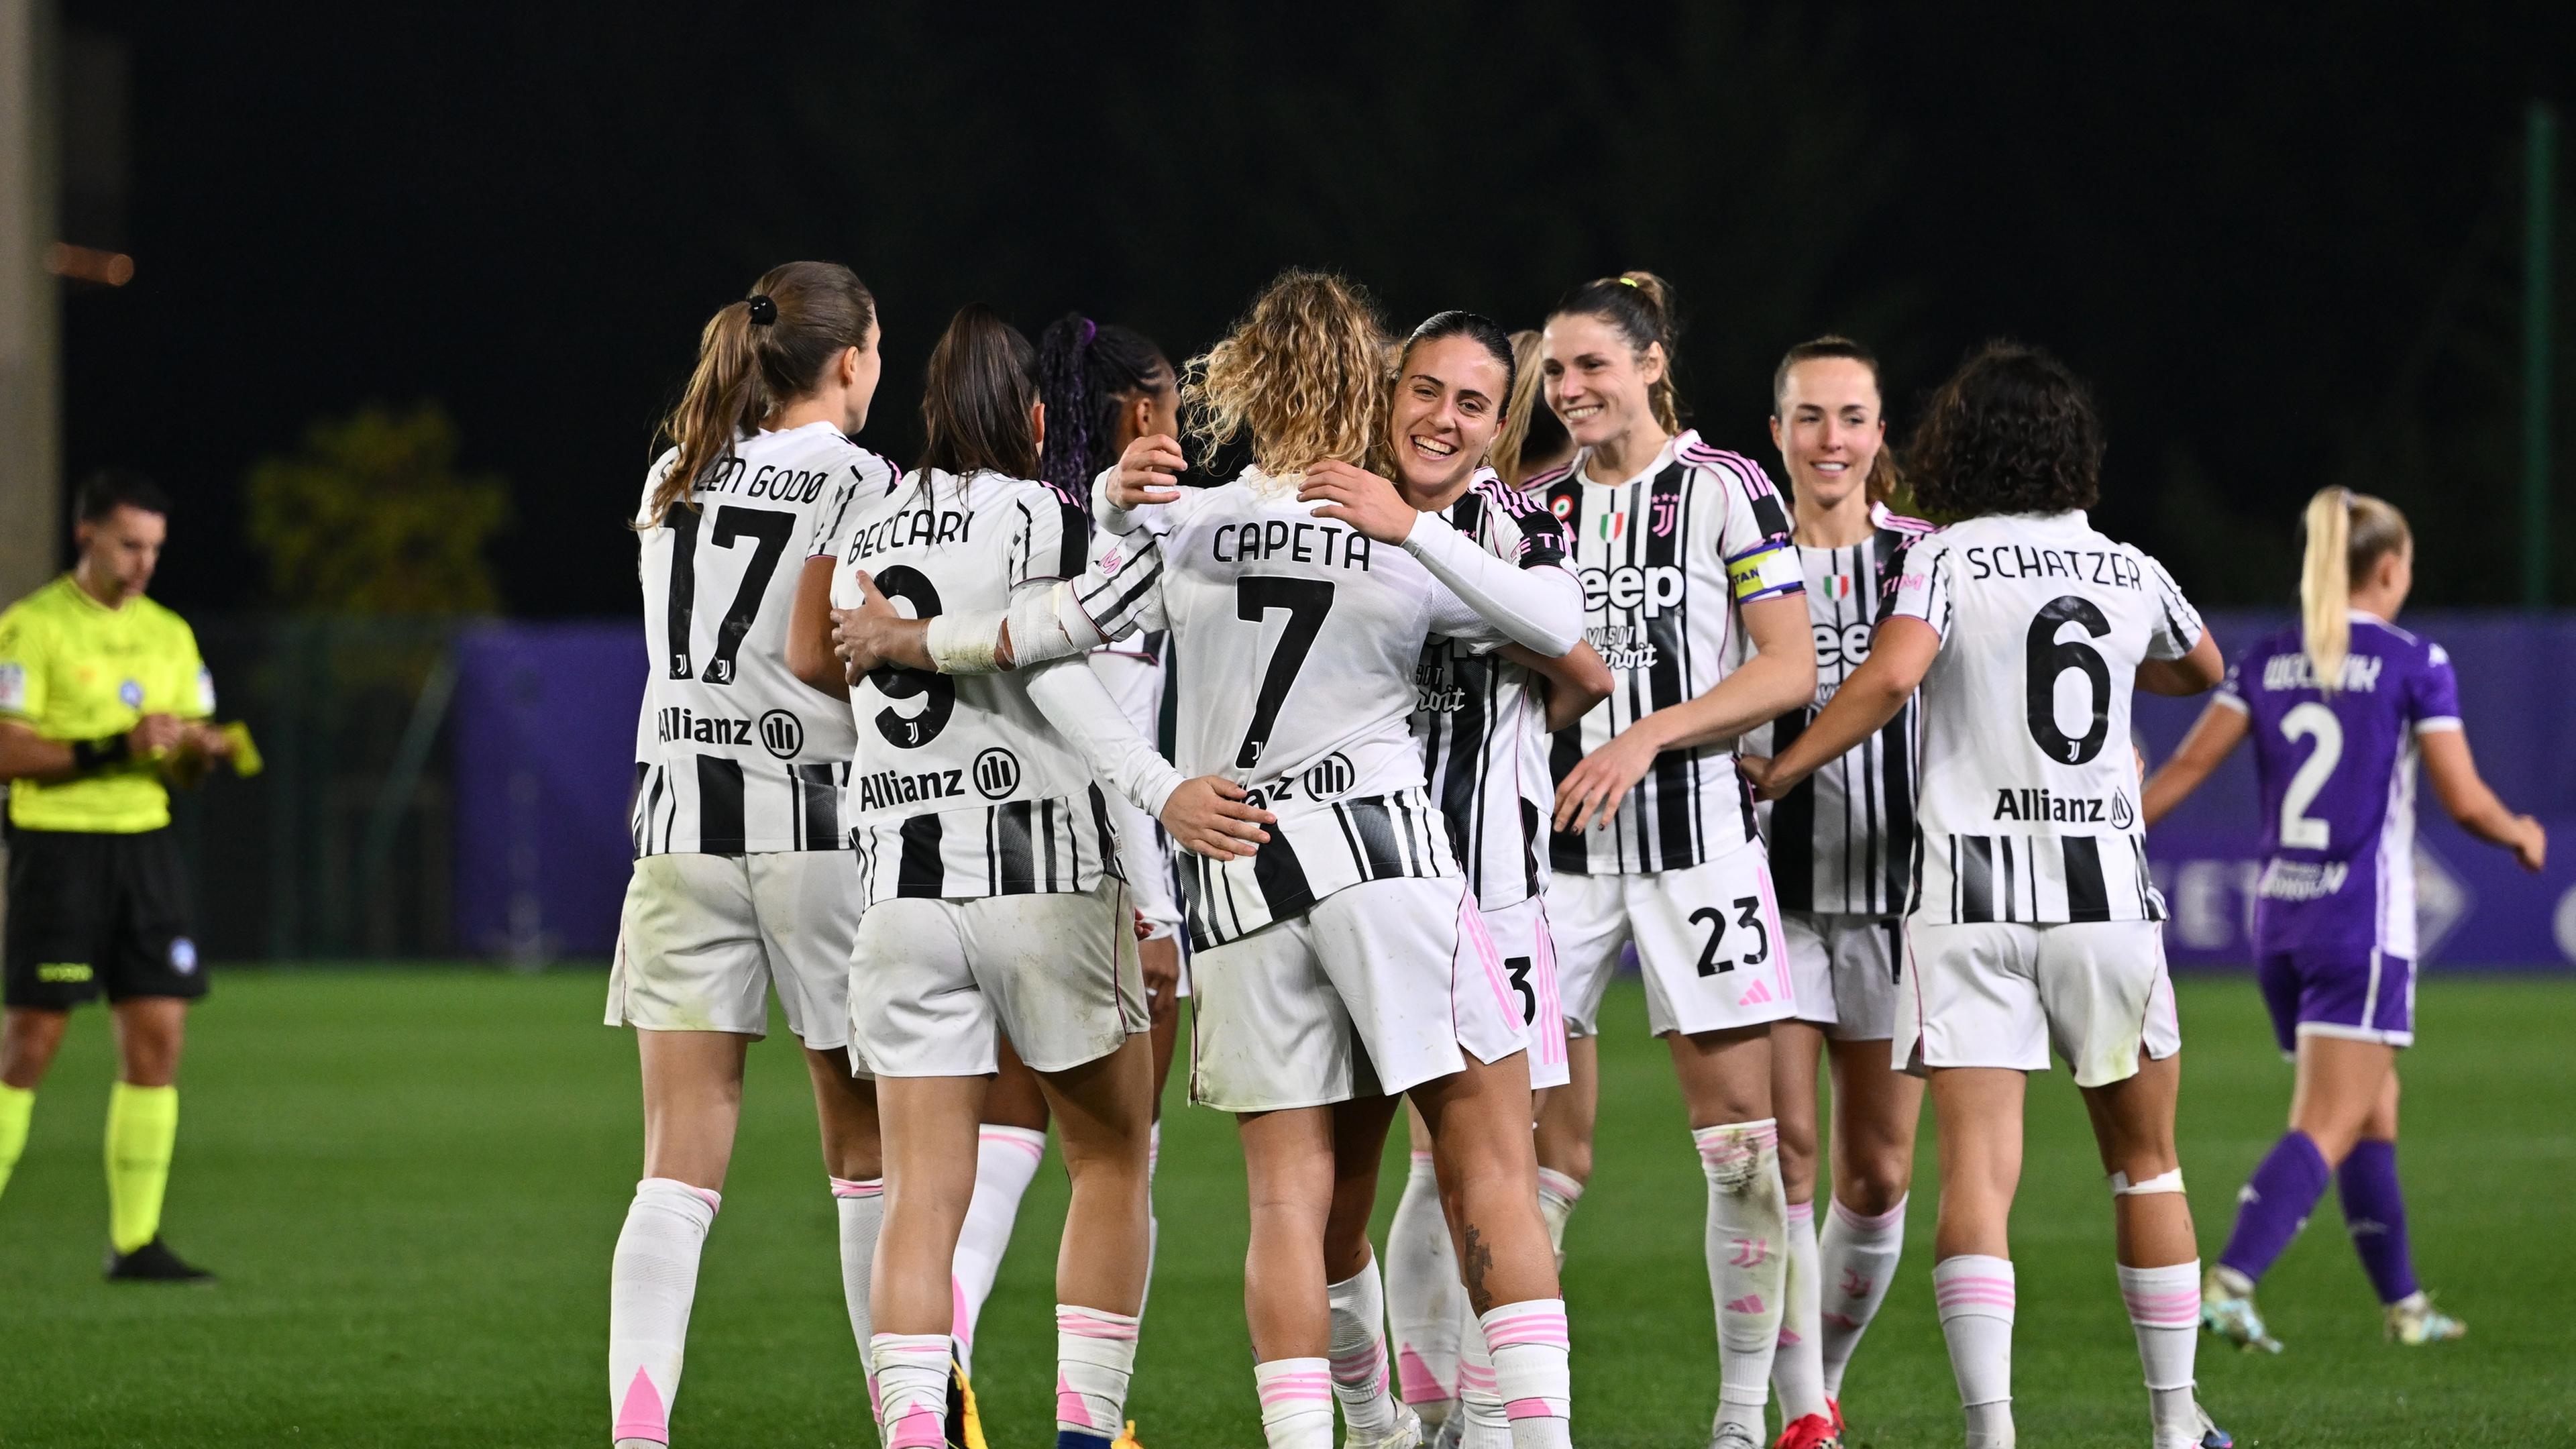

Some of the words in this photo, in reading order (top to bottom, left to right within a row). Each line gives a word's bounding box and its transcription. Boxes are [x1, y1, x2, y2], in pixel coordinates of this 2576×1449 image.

[747, 466, 828, 504] GODØ
[847, 509, 975, 566] BECCARI
[1213, 520, 1371, 572] CAPETA
[660, 501, 797, 686] 17
[1578, 566, 1685, 618] eep
[1882, 574, 1924, 598] TIM
[1967, 545, 2142, 591] SCHATZER
[870, 564, 955, 749] 9
[1236, 576, 1335, 769] 7
[1599, 642, 1658, 669] troit
[2027, 595, 2111, 765] 6
[1417, 687, 1465, 712] roit
[658, 707, 752, 747] Allianz
[860, 769, 965, 812] Allianz
[2281, 702, 2343, 850] 2
[1994, 789, 2106, 821] Allianz
[1688, 896, 1768, 977] 23
